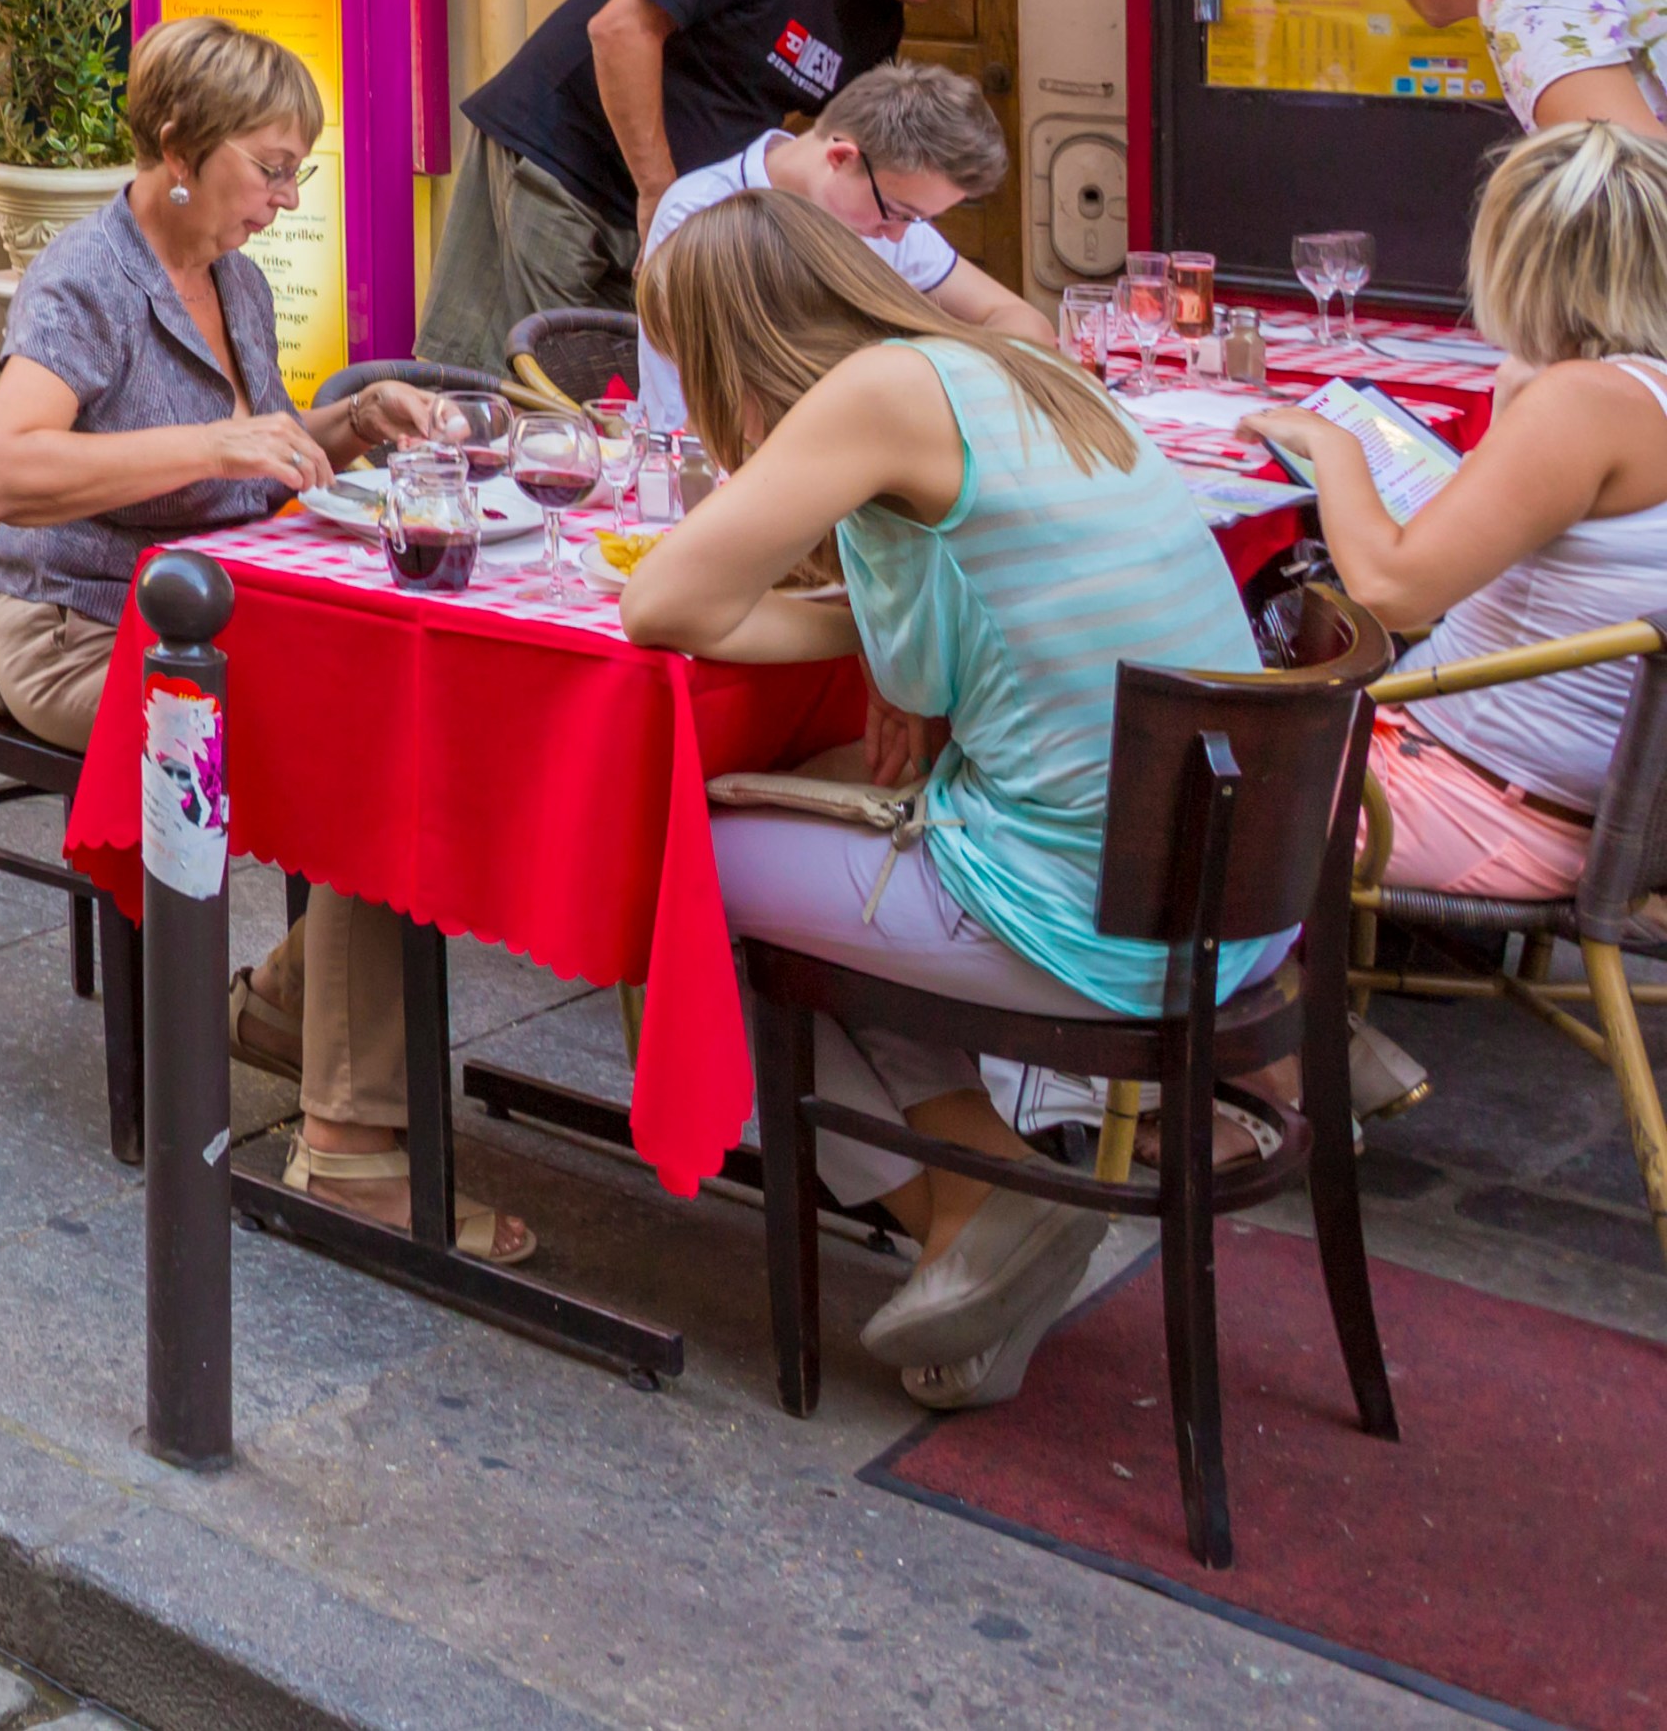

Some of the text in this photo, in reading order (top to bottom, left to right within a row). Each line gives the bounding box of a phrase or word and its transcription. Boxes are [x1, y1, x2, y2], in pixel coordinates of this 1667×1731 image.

[203, 6, 216, 15] au
[218, 5, 264, 19] fromage
[284, 228, 325, 243] grillée
[262, 255, 293, 269] frites
[286, 281, 319, 297] frites
[290, 367, 316, 382] jour
